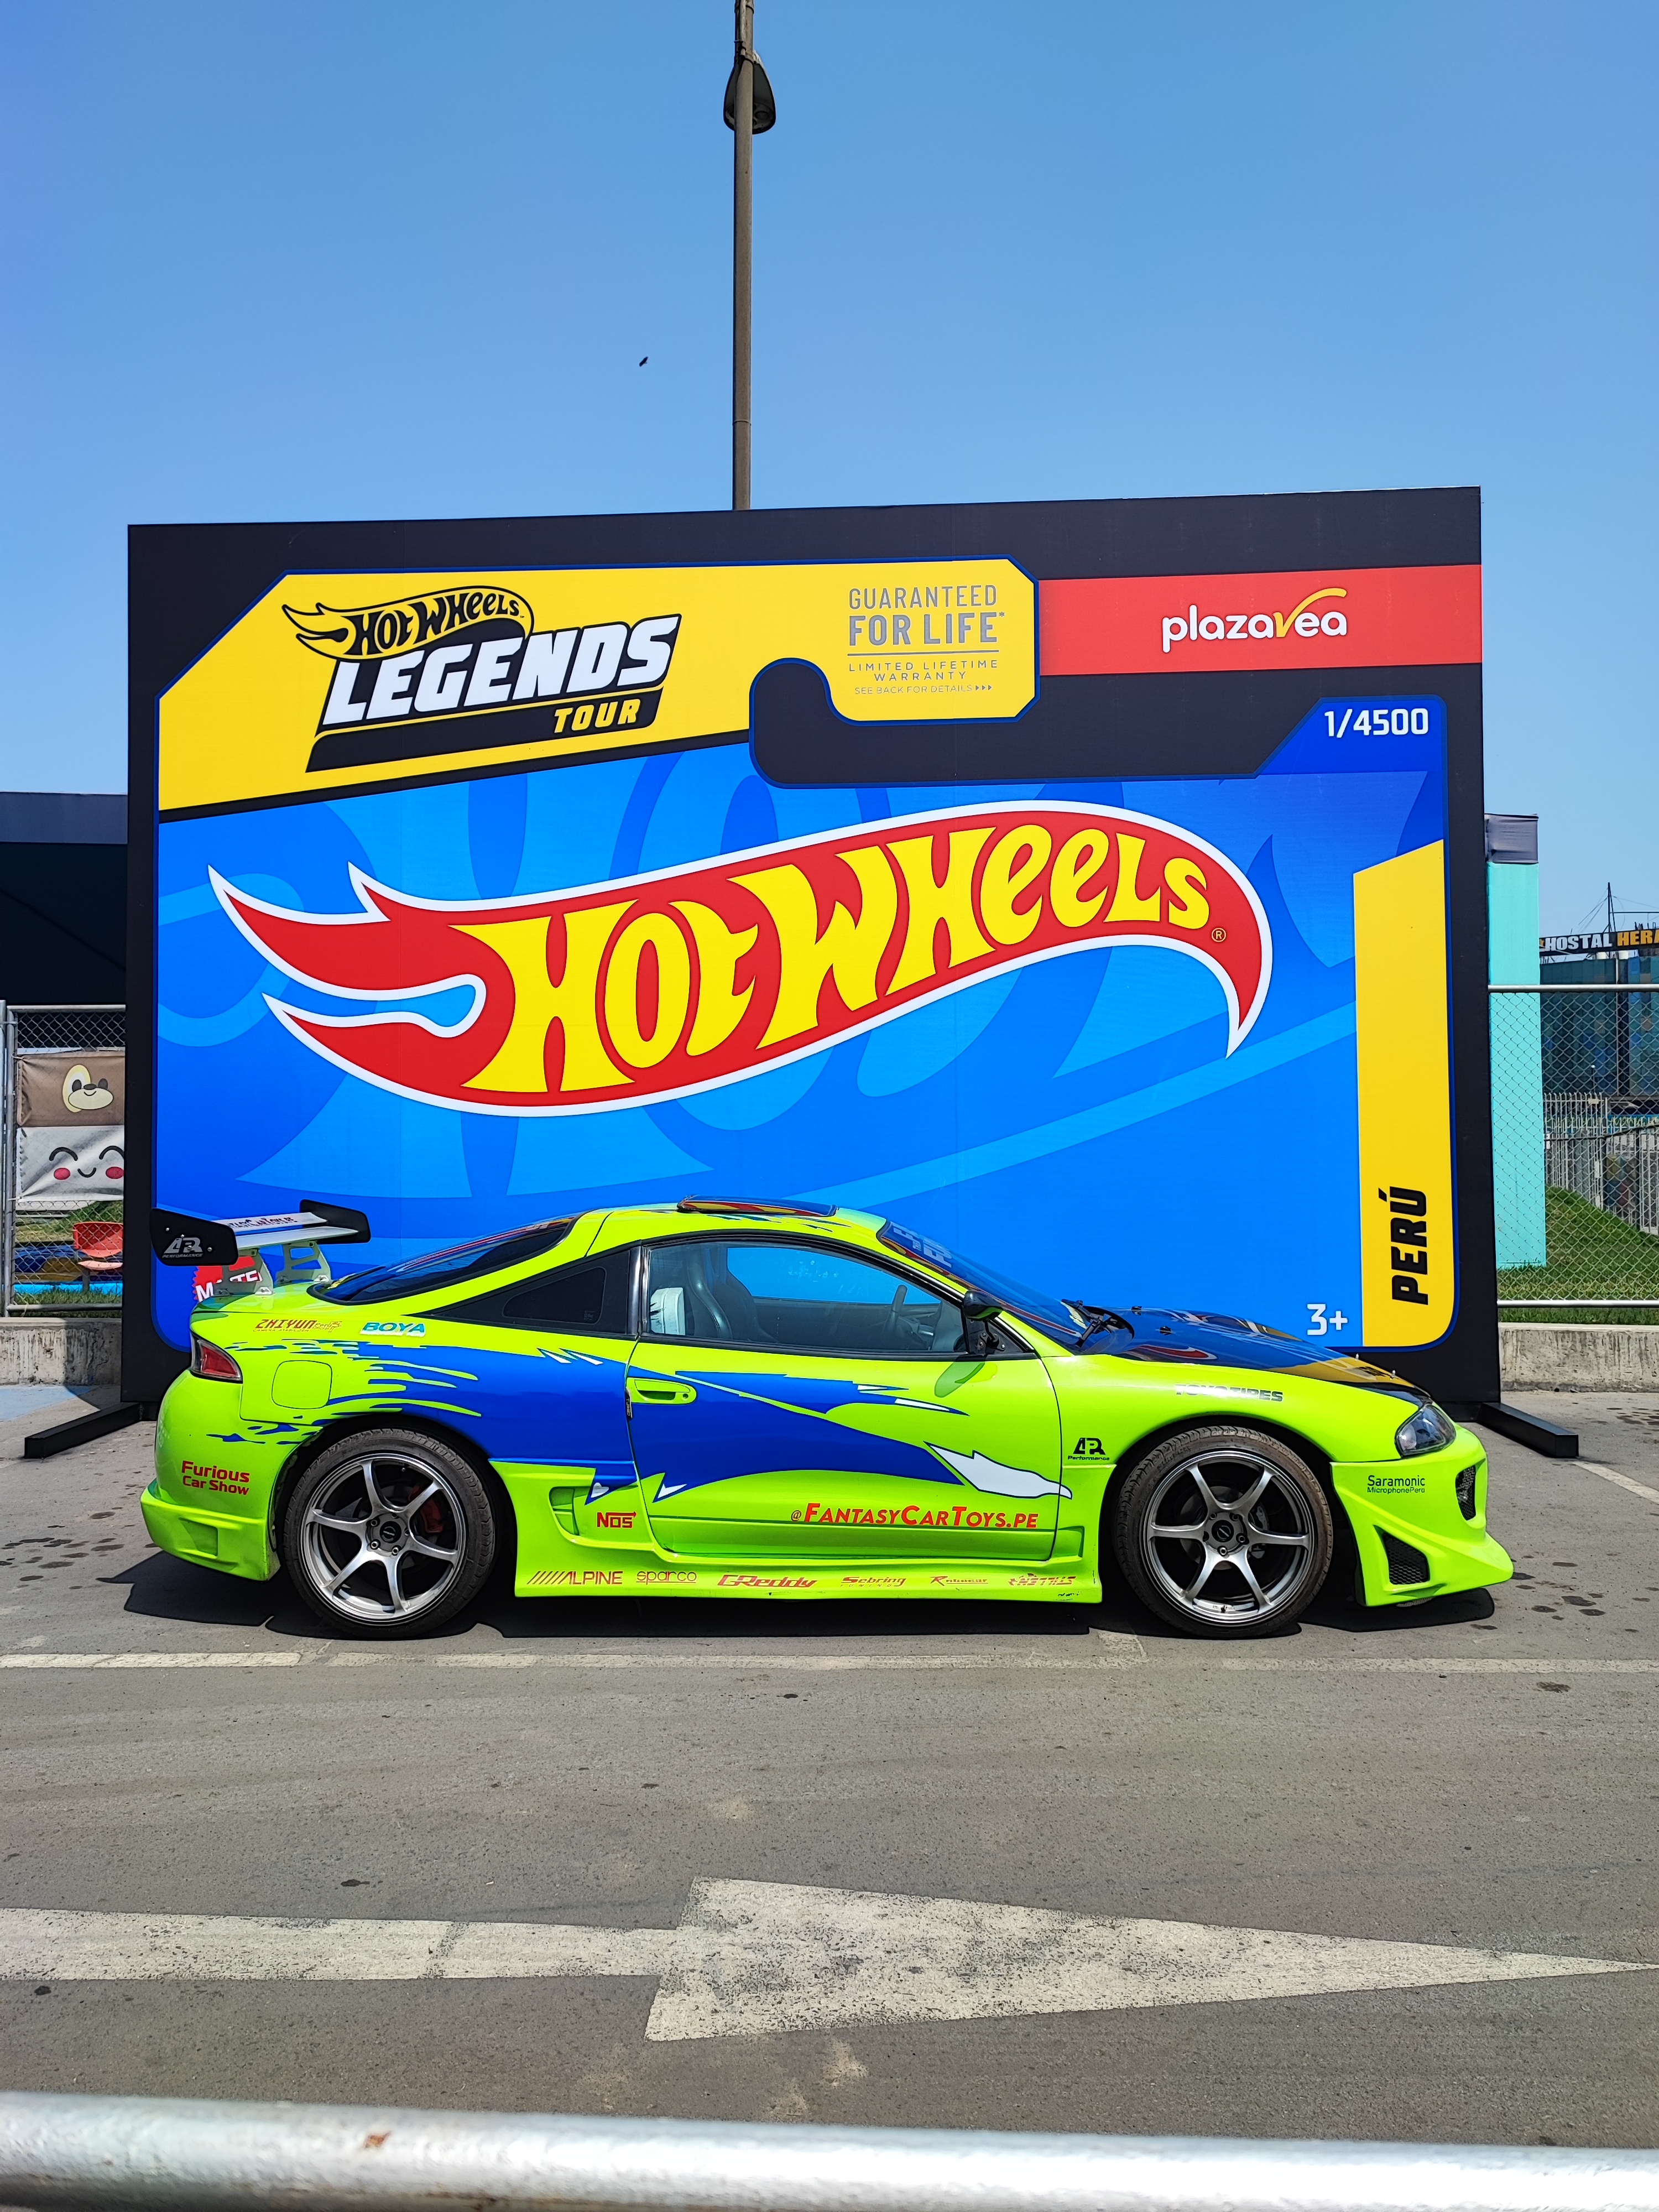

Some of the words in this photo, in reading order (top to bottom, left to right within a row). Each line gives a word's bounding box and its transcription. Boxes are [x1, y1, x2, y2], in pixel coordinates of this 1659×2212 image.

[849, 585, 997, 609] GUARANTEED
[849, 614, 911, 646] FOR
[1162, 588, 1347, 653] plazavea
[322, 616, 679, 726] LEGENDS
[849, 661, 914, 672] LIMITED
[923, 660, 998, 670] LIFETIME
[874, 671, 966, 681] WARRANTY
[931, 684, 973, 693] DETAILS
[554, 699, 640, 733] TOUR
[1324, 708, 1429, 738] 1/4500
[1545, 933, 1613, 951] HOSTAL
[1378, 1186, 1428, 1305] PERÚ
[363, 1322, 425, 1332] BOYA
[1307, 1303, 1348, 1335] 3+
[181, 1460, 250, 1483] Furious
[1367, 1475, 1426, 1486] Saramonic
[182, 1475, 207, 1489] Car
[208, 1479, 249, 1495] Show
[597, 1511, 636, 1528] NOS
[637, 1571, 697, 1585] sparco
[841, 1575, 907, 1587] Sebring
